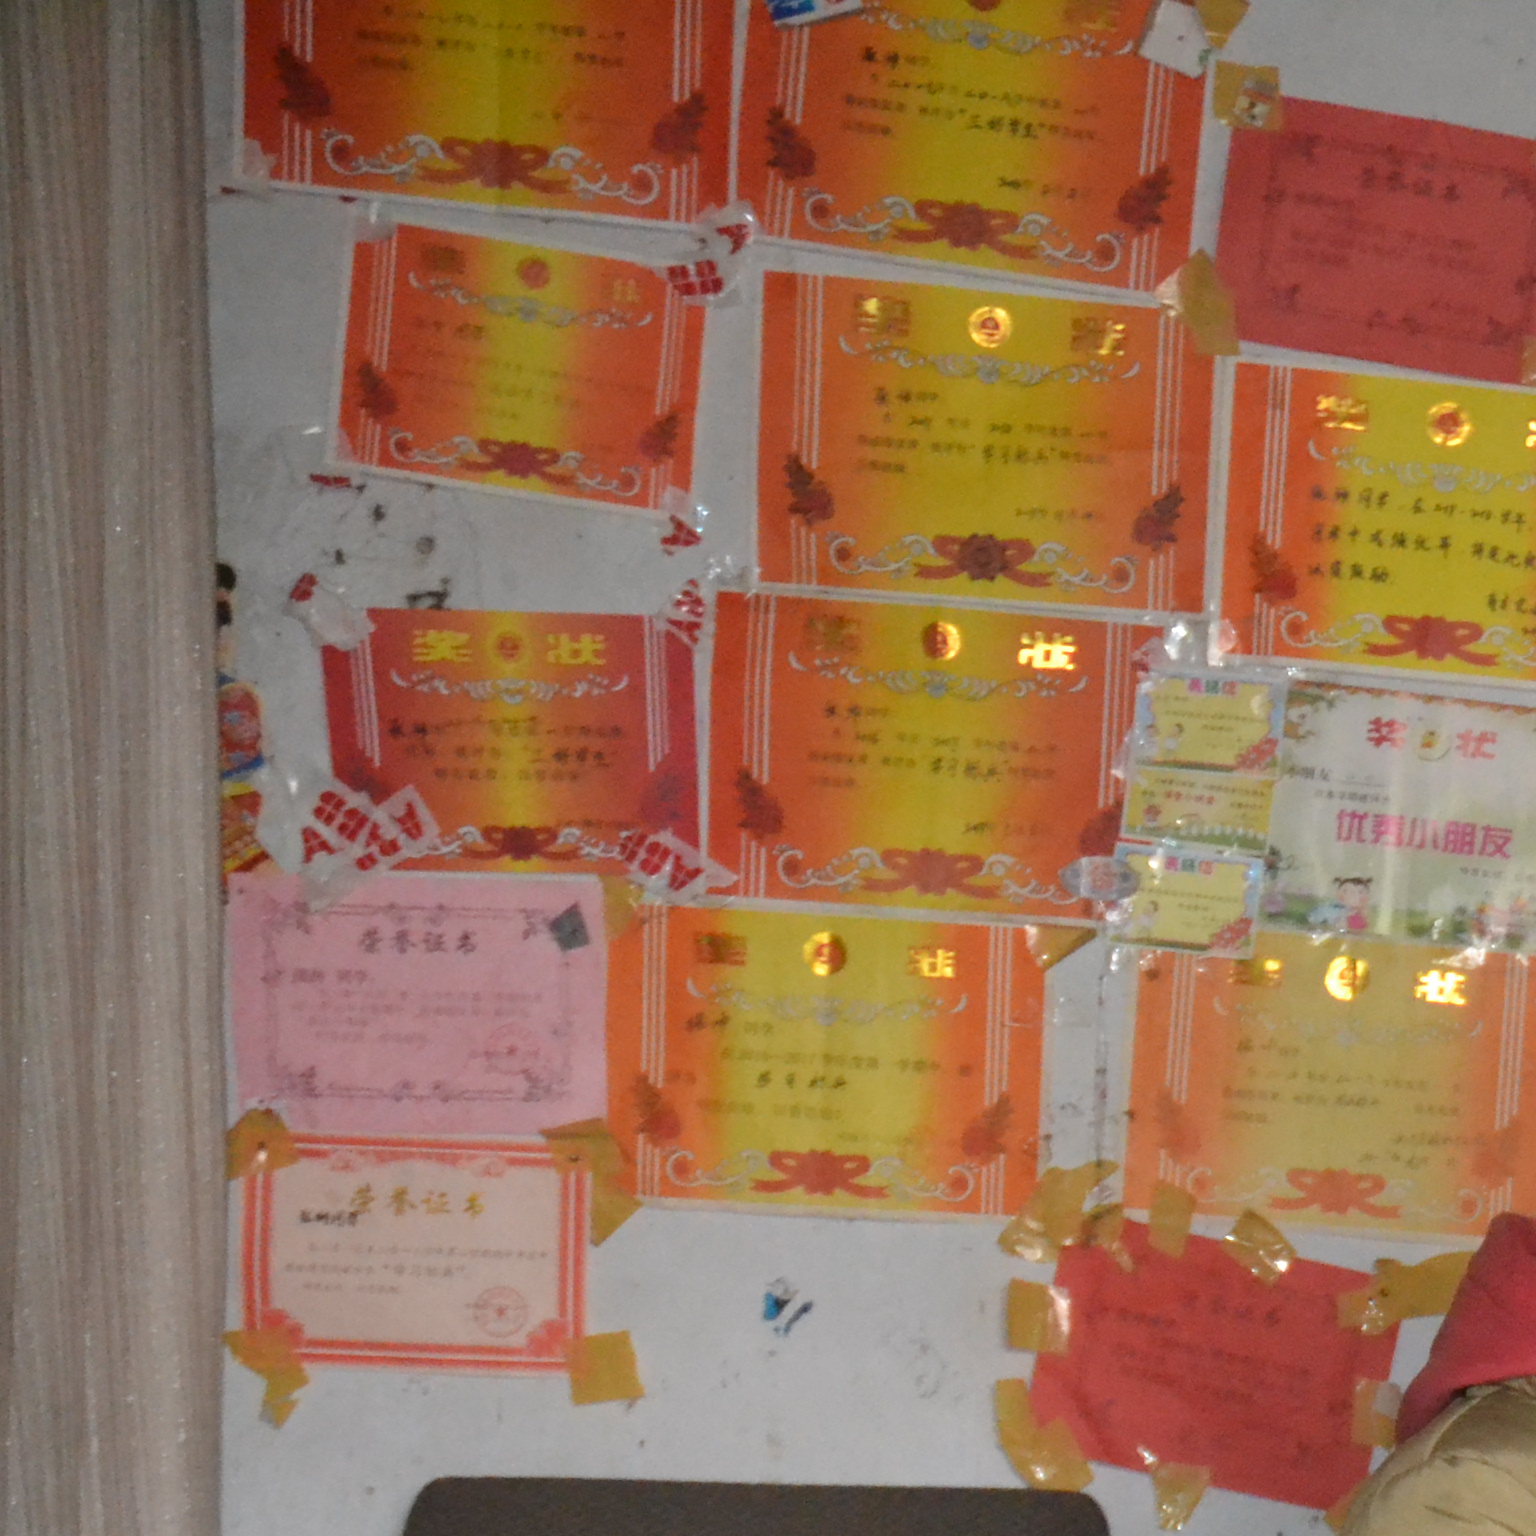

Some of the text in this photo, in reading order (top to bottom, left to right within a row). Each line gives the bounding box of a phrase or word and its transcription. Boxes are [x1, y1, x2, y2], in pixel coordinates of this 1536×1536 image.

[411, 628, 607, 667] 奖 状
[1366, 715, 1500, 761] 奖 状
[1335, 807, 1515, 861] 优秀小朋友
[357, 926, 479, 956] 荣誉证书
[350, 1183, 487, 1219] 荣誉证书
